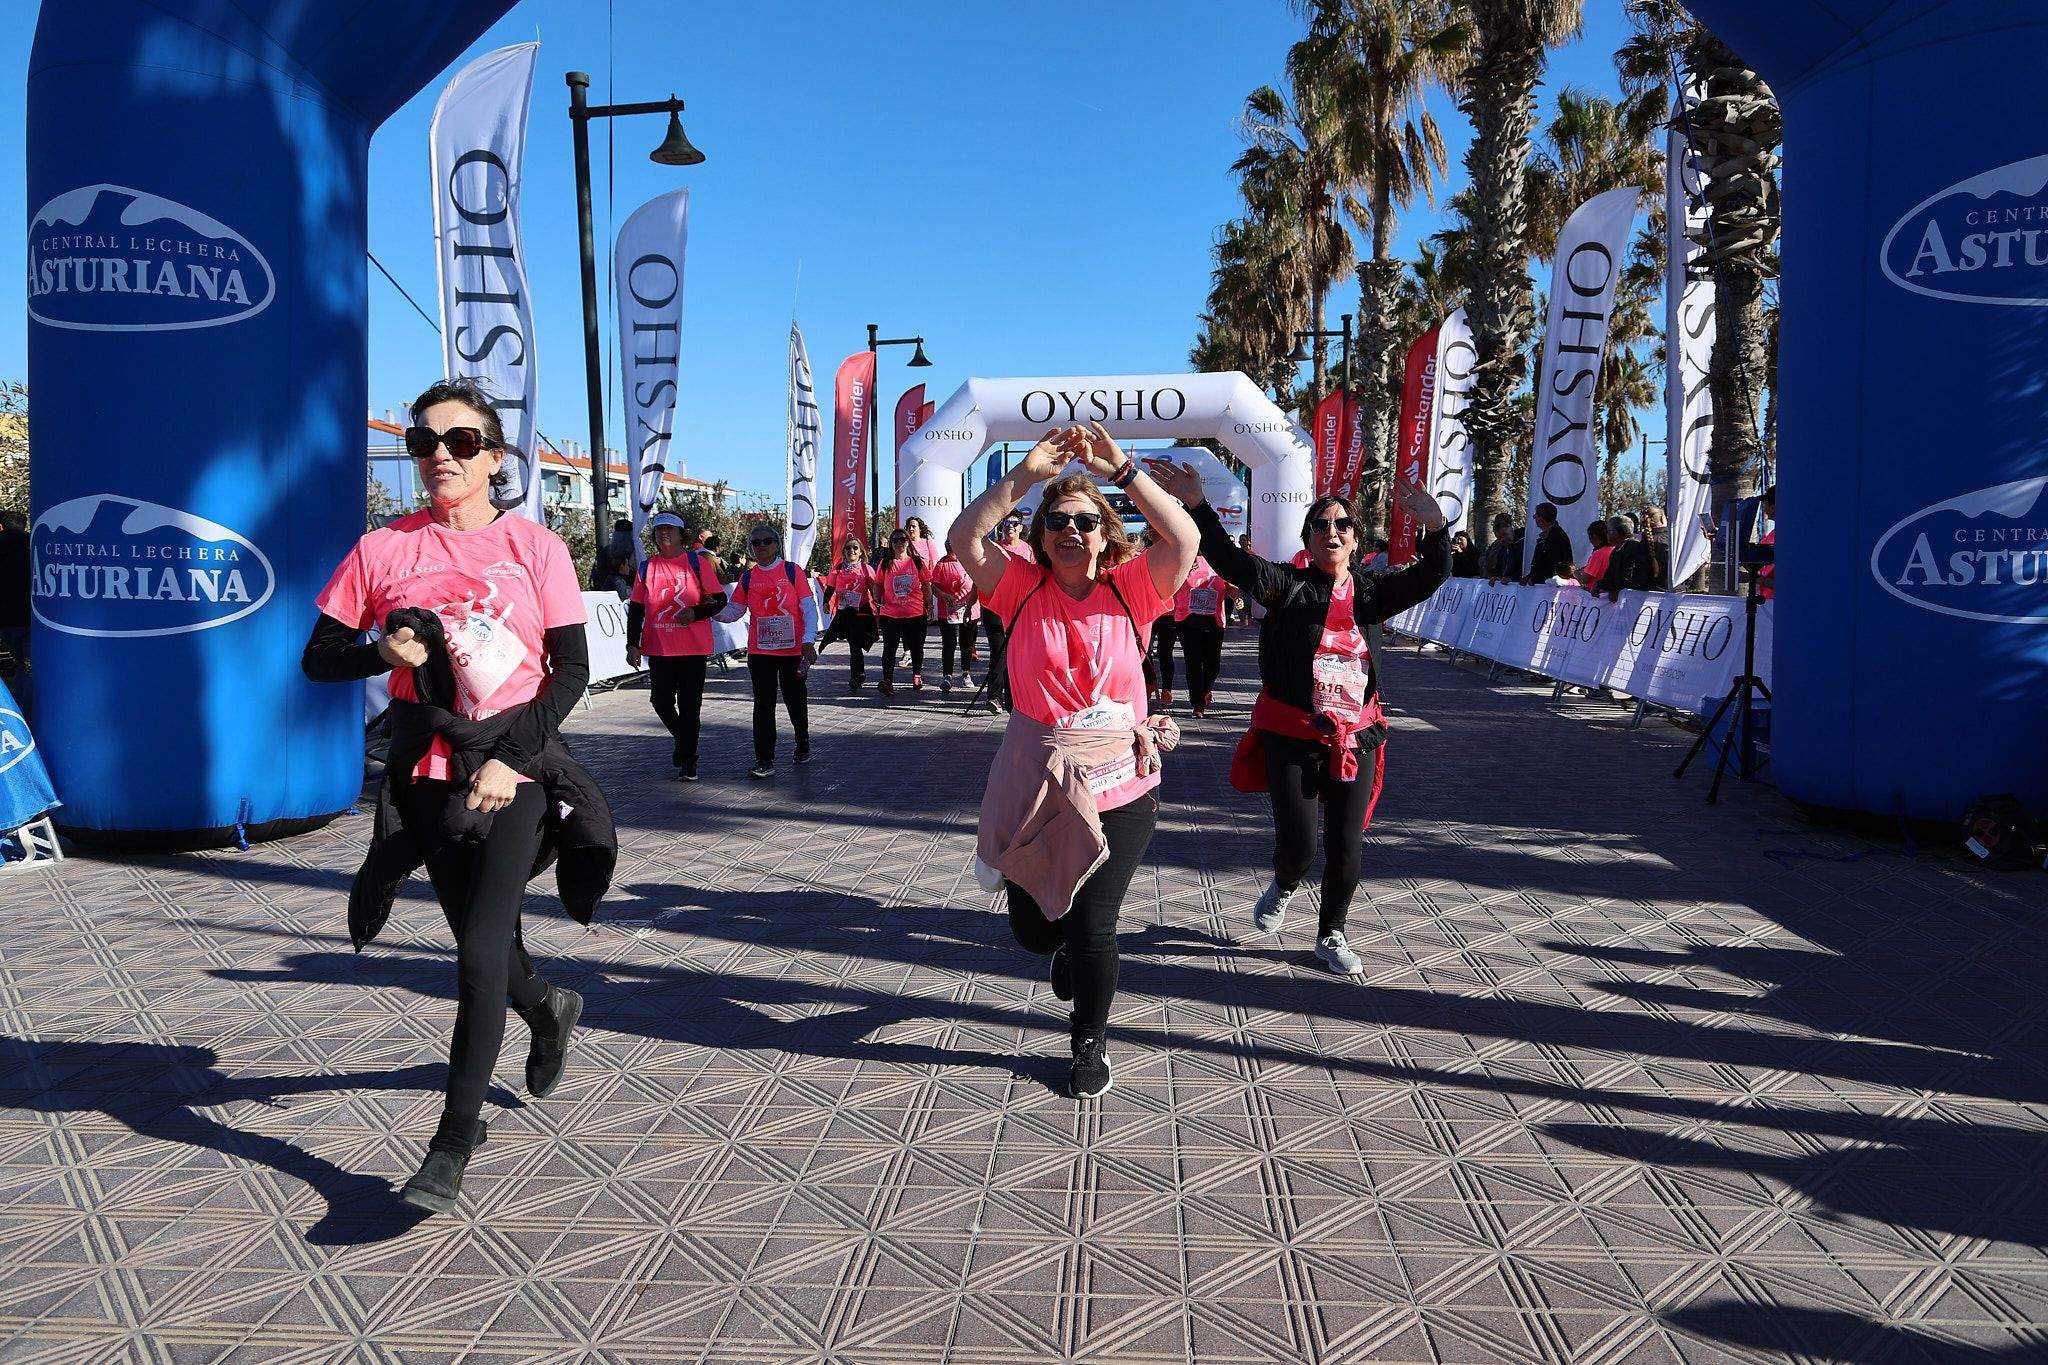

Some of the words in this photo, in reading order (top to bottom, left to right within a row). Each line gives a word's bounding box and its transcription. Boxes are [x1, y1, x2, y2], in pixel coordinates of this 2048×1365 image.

[43, 235, 119, 252] CENTRAL
[130, 237, 240, 261] LECHERA
[1905, 219, 2048, 278] ASTU
[28, 245, 252, 305] ASTURIANA
[628, 253, 679, 512] OYSHO
[1541, 241, 1613, 506] OYSHO
[846, 378, 865, 469] Santander
[1021, 387, 1186, 424] OYSHO
[1234, 422, 1284, 435] OYSHO
[1410, 354, 1437, 456] Santander
[925, 429, 973, 441] OYSHO
[1323, 413, 1337, 485] Santander
[903, 495, 948, 507] OYSHO
[1261, 491, 1307, 504] OYSHO
[32, 545, 252, 602] ASTURIANA
[46, 542, 120, 557] CENTRAL
[131, 545, 240, 561] LECHERA
[1896, 532, 2048, 586] ASTU
[1473, 591, 1517, 626] OYSHO
[1532, 599, 1601, 643] OYSHO
[1631, 605, 1733, 662] OYSHO
[1316, 681, 1344, 695] 016
